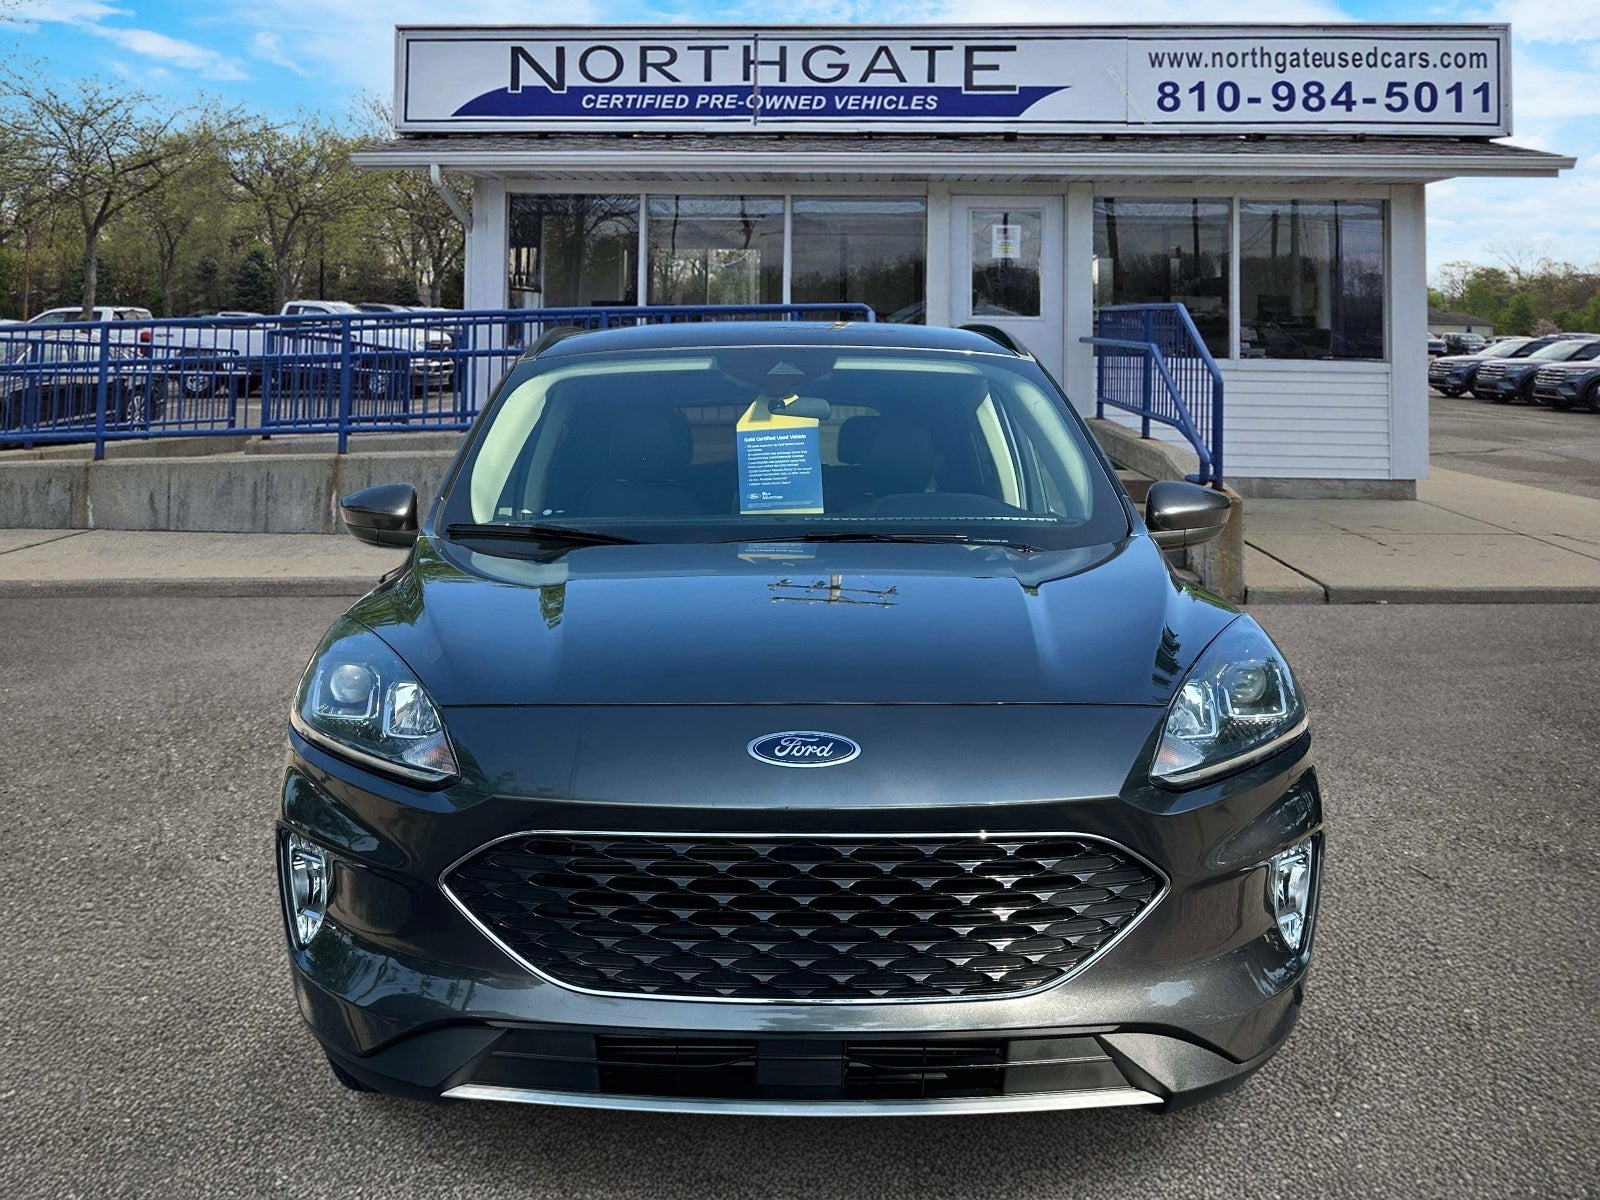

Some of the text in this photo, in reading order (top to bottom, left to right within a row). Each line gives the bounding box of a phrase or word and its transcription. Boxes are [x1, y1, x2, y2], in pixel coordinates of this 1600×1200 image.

[509, 45, 1018, 93] NORTHGATE
[1148, 46, 1488, 74] www.northgateusedcars.com
[580, 92, 939, 111] CERTIFIED PRE-OWNED VEHICLES
[1156, 80, 1491, 113] 810-984-5011
[774, 737, 834, 757] Ford
